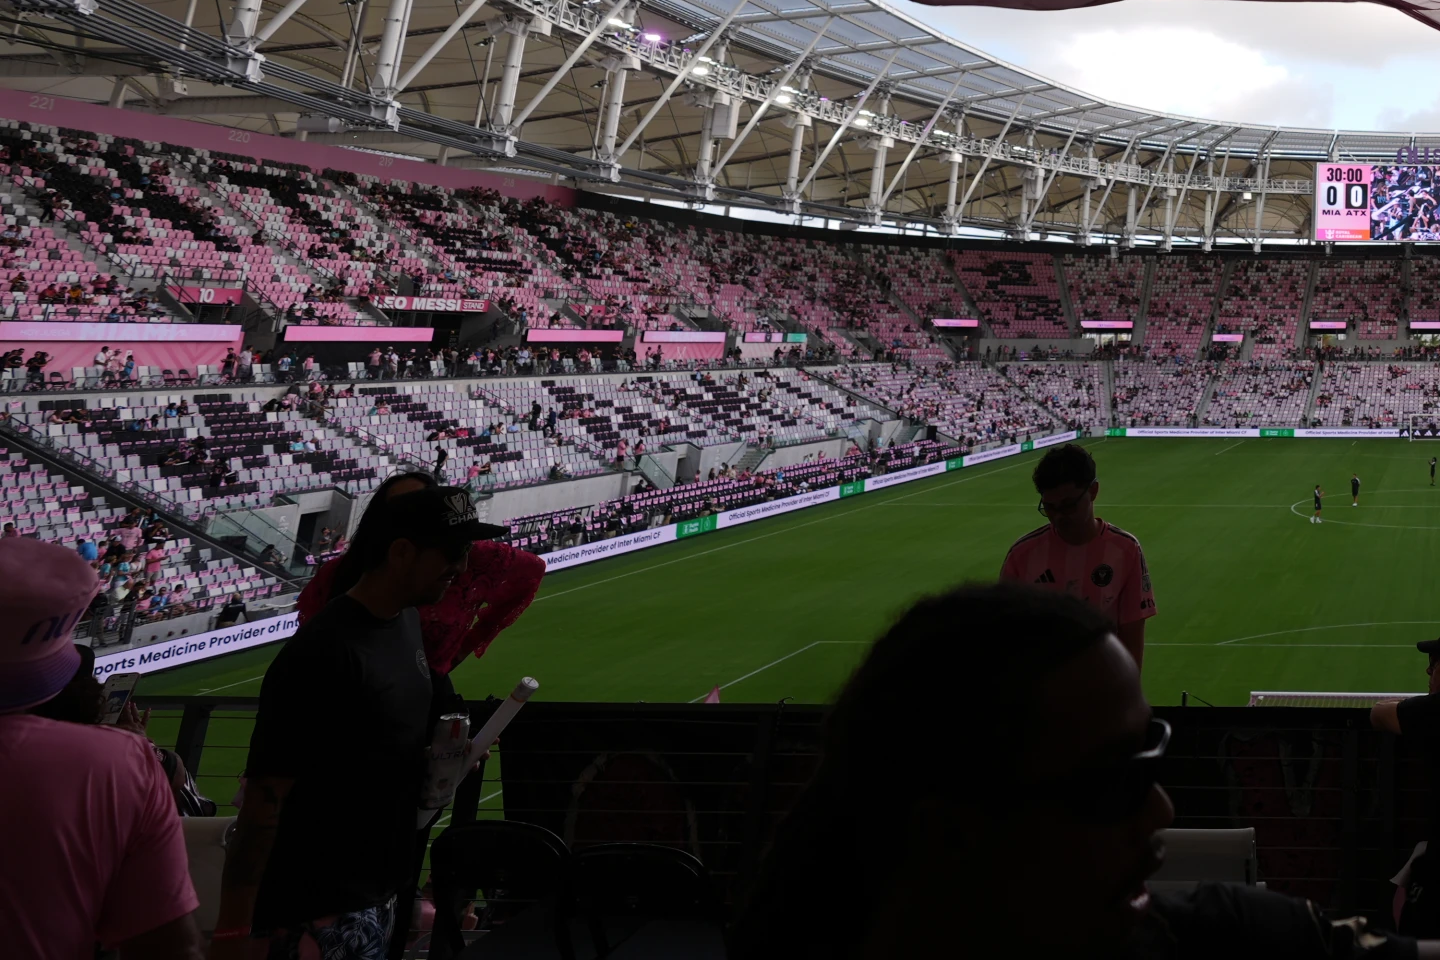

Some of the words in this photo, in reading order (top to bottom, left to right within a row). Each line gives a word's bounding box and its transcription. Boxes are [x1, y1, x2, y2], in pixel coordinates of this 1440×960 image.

[29, 95, 55, 111] 221
[228, 129, 250, 144] 220
[379, 157, 393, 168] 219
[1326, 168, 1362, 182] 30:00
[1326, 185, 1337, 206] 0
[1350, 185, 1363, 207] 0
[199, 288, 215, 303] 10
[374, 296, 407, 310] LEO
[411, 297, 461, 311] MESSI
[463, 301, 485, 310] STAND
[728, 511, 746, 520] Official
[746, 508, 760, 518] Sports
[547, 552, 580, 565] Medicine
[580, 544, 608, 558] Provider
[617, 538, 632, 548] Inter
[633, 534, 653, 546] Miami
[94, 656, 135, 676] ports
[139, 642, 206, 665] Medicine
[209, 628, 265, 647] Provider
[268, 621, 282, 633] of
[283, 618, 299, 630] Int
[431, 751, 465, 760] ULTRA
